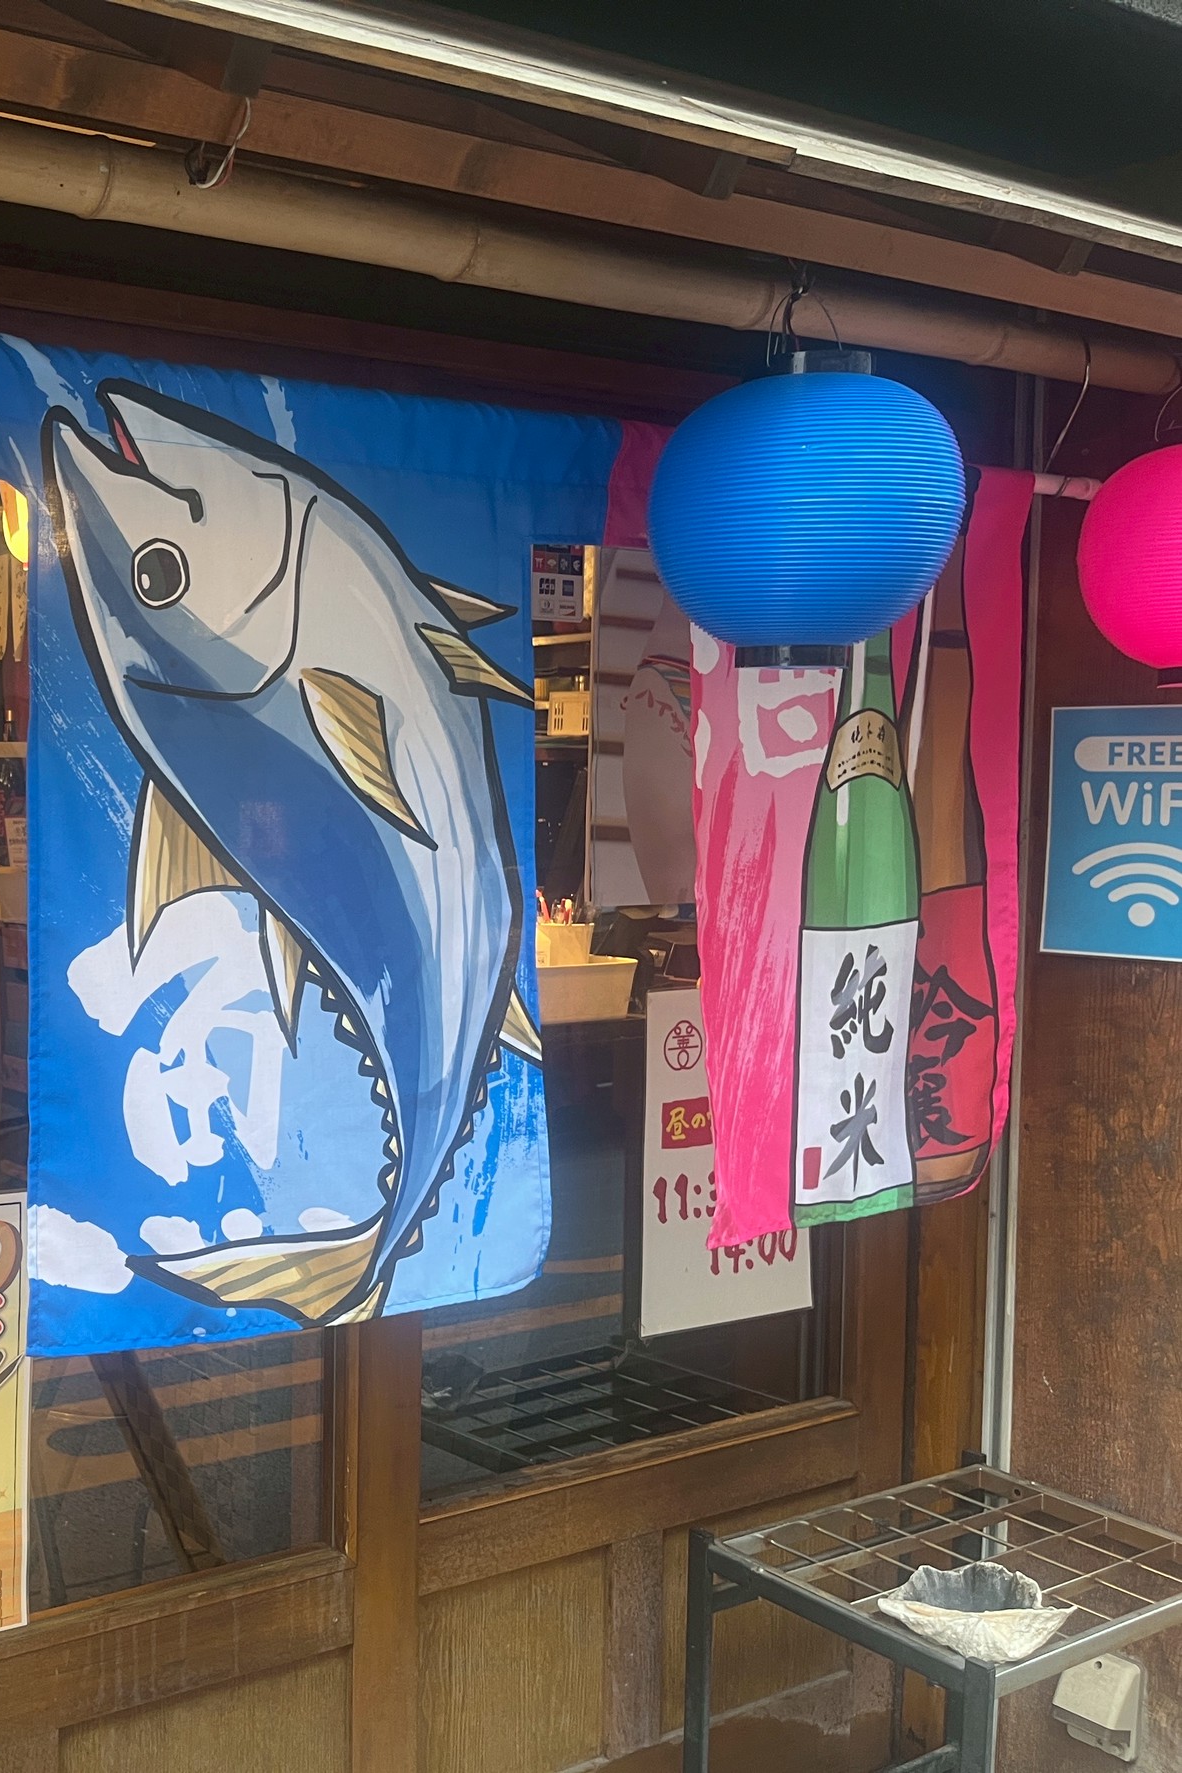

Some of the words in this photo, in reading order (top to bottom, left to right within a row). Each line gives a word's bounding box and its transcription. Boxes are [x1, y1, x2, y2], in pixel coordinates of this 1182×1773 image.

[1108, 742, 1182, 766] FREE
[822, 943, 895, 1192] 純米
[666, 1107, 712, 1141] 昼の
